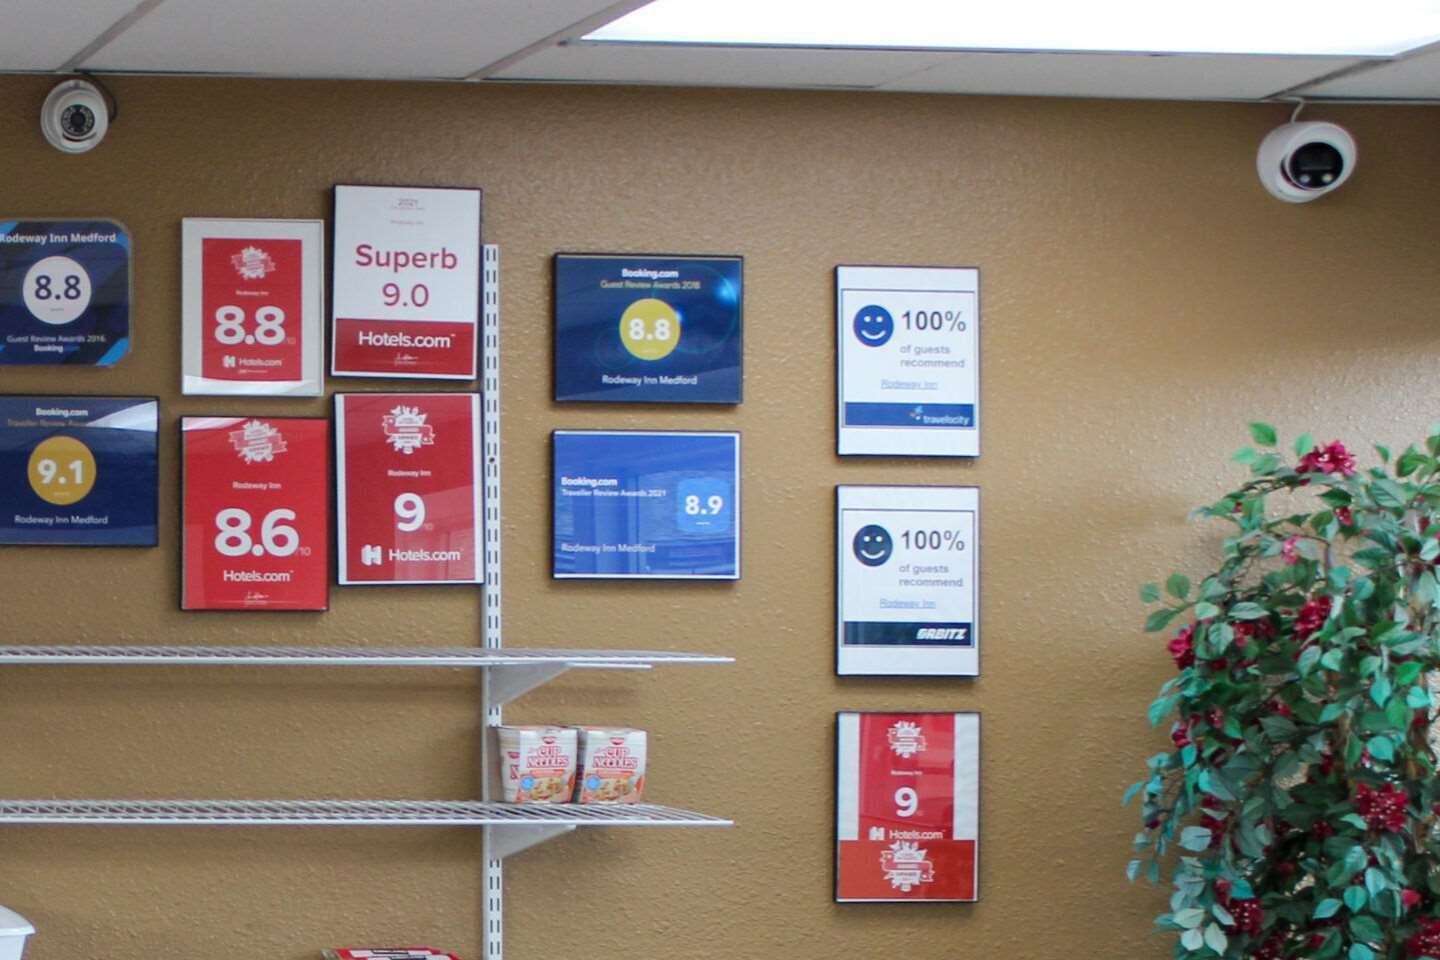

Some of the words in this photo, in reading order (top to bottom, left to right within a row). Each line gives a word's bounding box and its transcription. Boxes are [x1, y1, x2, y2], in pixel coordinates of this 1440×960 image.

[49, 233, 68, 243] Inn
[70, 232, 117, 243] Medford
[355, 243, 458, 273] Superb
[621, 268, 679, 279] Booking.com
[34, 275, 81, 300] 8.8
[382, 282, 429, 307] 9.0
[214, 305, 286, 345] 8.8
[901, 310, 967, 332] 100%
[628, 318, 671, 340] 8.8
[358, 330, 452, 348] Hotels.com
[899, 344, 912, 354] of
[913, 345, 951, 356] guests
[239, 357, 283, 367] Hotels.com
[899, 358, 966, 369] recommend
[601, 374, 642, 386] Rodeway
[643, 375, 658, 384] Inn
[659, 375, 698, 385] Medford
[35, 407, 89, 417] Booking.com
[923, 414, 970, 426] travelocity
[37, 459, 84, 485] 9.1
[387, 469, 419, 478] Rodeway
[420, 469, 432, 477] Inn
[232, 481, 267, 490] Rodeway
[269, 481, 282, 489] Inn
[561, 476, 618, 487] Booking.com
[684, 495, 724, 515] 8.9
[394, 492, 426, 532] 9
[14, 515, 54, 526] Rodeway
[55, 515, 69, 524] Inn
[71, 515, 109, 525] Medford
[214, 507, 300, 557] 8.6
[901, 529, 966, 551] 100%
[561, 543, 601, 554] Rodeway
[602, 543, 617, 553] Inn
[618, 543, 656, 553] Medford
[388, 549, 461, 561] Hotels.com
[898, 564, 911, 573] of
[912, 565, 949, 576] guests
[223, 570, 291, 583] Hotels.com
[898, 577, 964, 588] recommend
[916, 628, 968, 641] ORBITZ
[527, 756, 570, 769] NOODLES
[592, 756, 638, 769] NOODLES
[894, 786, 919, 818] 9
[889, 829, 944, 840] Hotels.com
